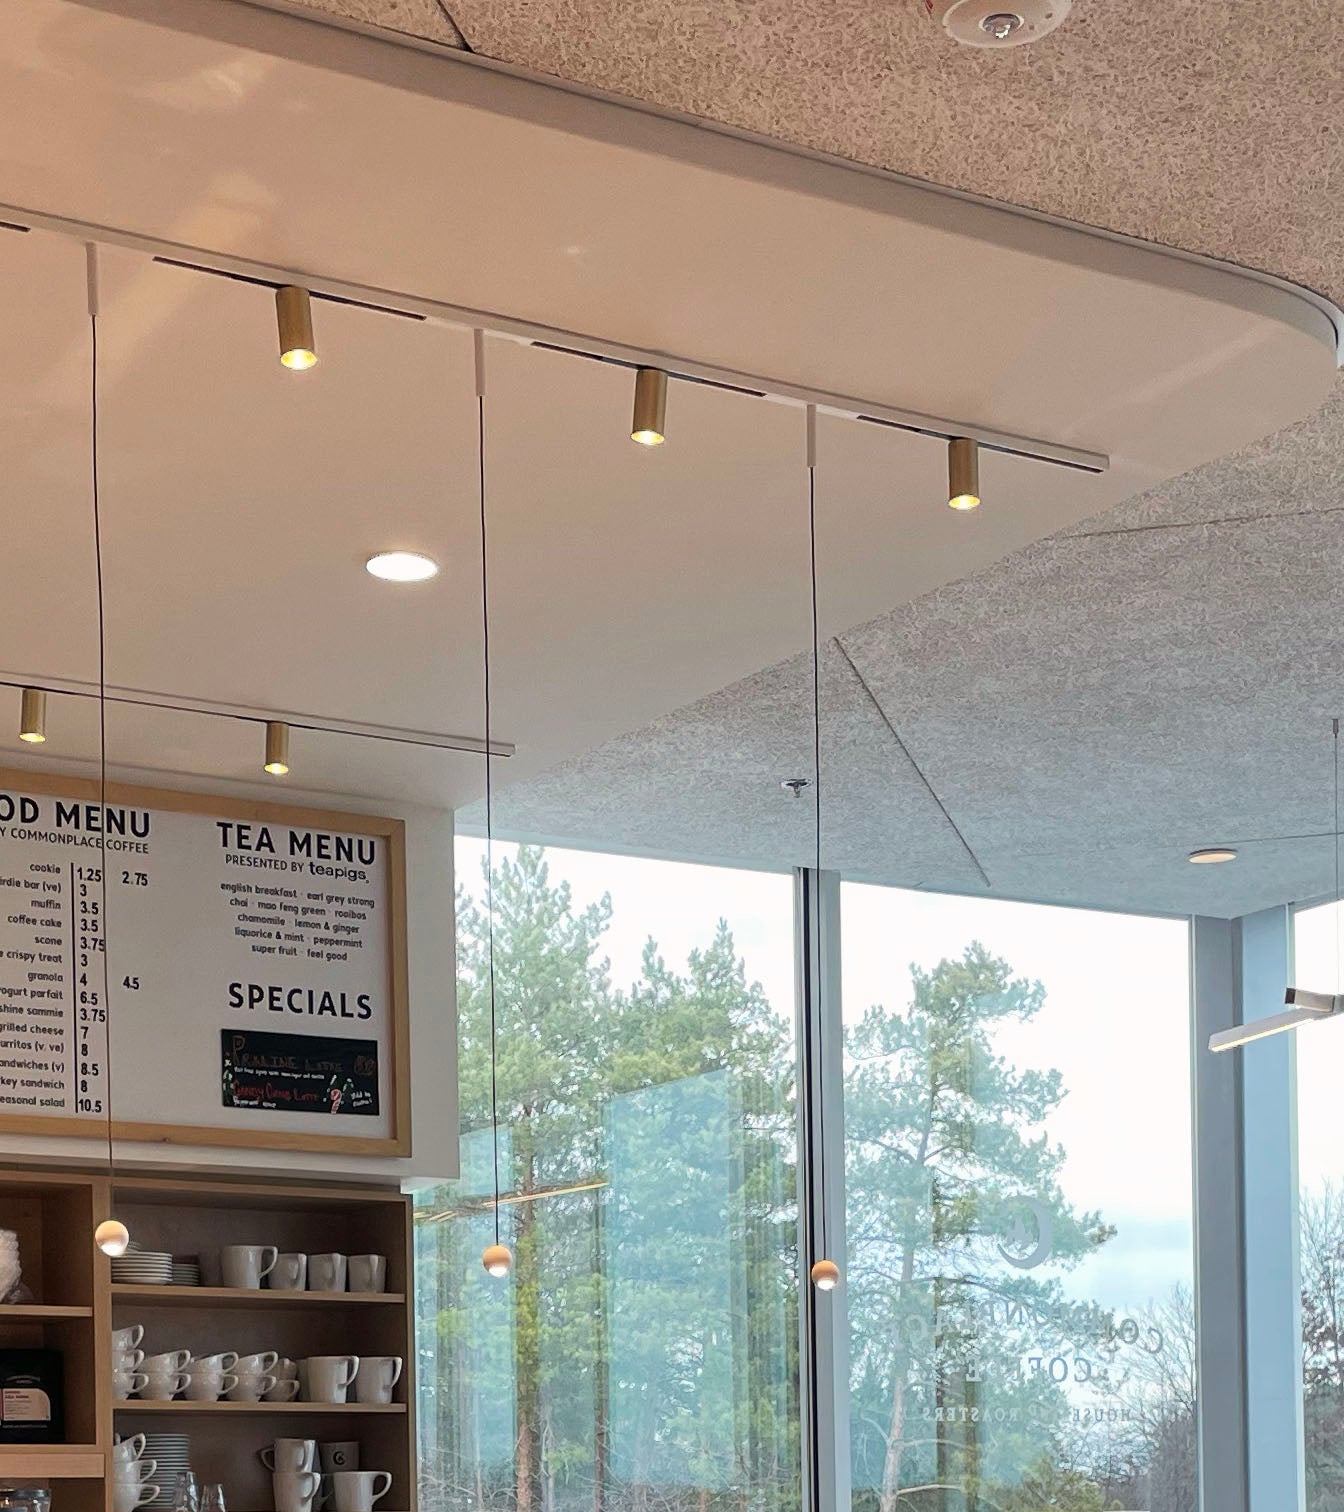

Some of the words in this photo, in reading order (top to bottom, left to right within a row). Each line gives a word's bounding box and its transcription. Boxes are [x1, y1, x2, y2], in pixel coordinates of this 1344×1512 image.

[55, 800, 150, 838] MENU
[11, 827, 103, 849] COMMONPLACE
[106, 838, 149, 854] COFFEE
[216, 821, 275, 853] TEA
[289, 830, 375, 865] MENU
[29, 862, 61, 874] cookie
[225, 853, 288, 871] PRESENTED
[290, 861, 305, 873] BY
[23, 879, 40, 889] bar
[220, 883, 253, 894] english
[255, 885, 298, 898] breakfast
[326, 893, 345, 905] grey
[347, 895, 375, 908] strong
[30, 899, 61, 910] muffin
[229, 898, 248, 908] chai
[301, 905, 326, 917] green
[7, 914, 37, 925] coffee
[40, 917, 62, 928] cake
[237, 913, 285, 926] chamomile
[332, 922, 360, 935] ginger
[34, 935, 62, 946] scone
[284, 932, 304, 942] mint
[313, 936, 363, 948] peppermint
[6, 949, 35, 963] crispy
[38, 953, 62, 964] treat
[251, 944, 276, 955] super
[278, 945, 298, 957] fruit
[307, 948, 323, 959] feel
[326, 951, 348, 962] good
[27, 970, 63, 983] granola
[30, 988, 63, 1000] parfait
[228, 982, 373, 1020] SPECIALS
[27, 1006, 64, 1018] sammie
[30, 1024, 64, 1036] cheese
[20, 1078, 65, 1090] sandwich
[80, 1079, 88, 1093] 8
[39, 1097, 65, 1108] salad
[78, 1099, 102, 1113] 10.5
